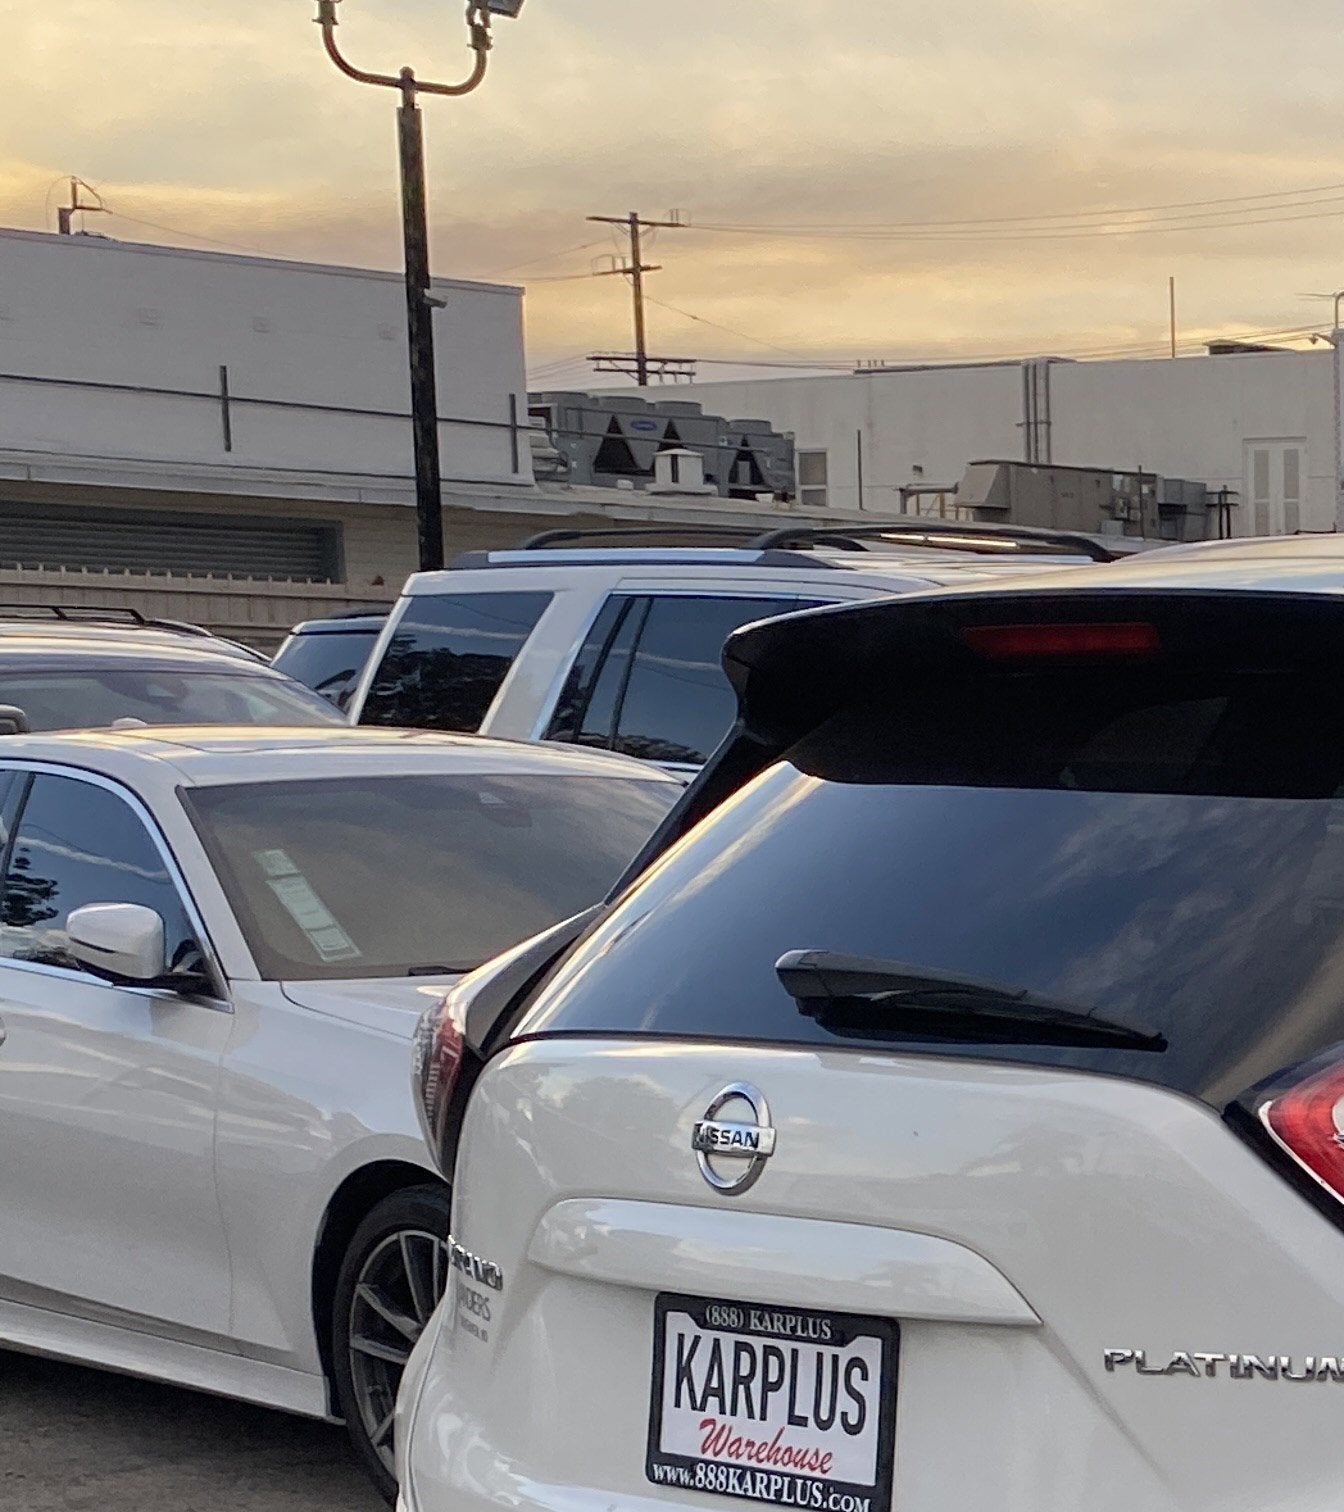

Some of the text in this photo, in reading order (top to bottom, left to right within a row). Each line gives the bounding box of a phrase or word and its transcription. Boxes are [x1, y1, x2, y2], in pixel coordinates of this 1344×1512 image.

[705, 1305, 832, 1340] (888) KARPLUS
[673, 1332, 869, 1436] KARPLUS
[699, 1417, 834, 1475] Warehouse
